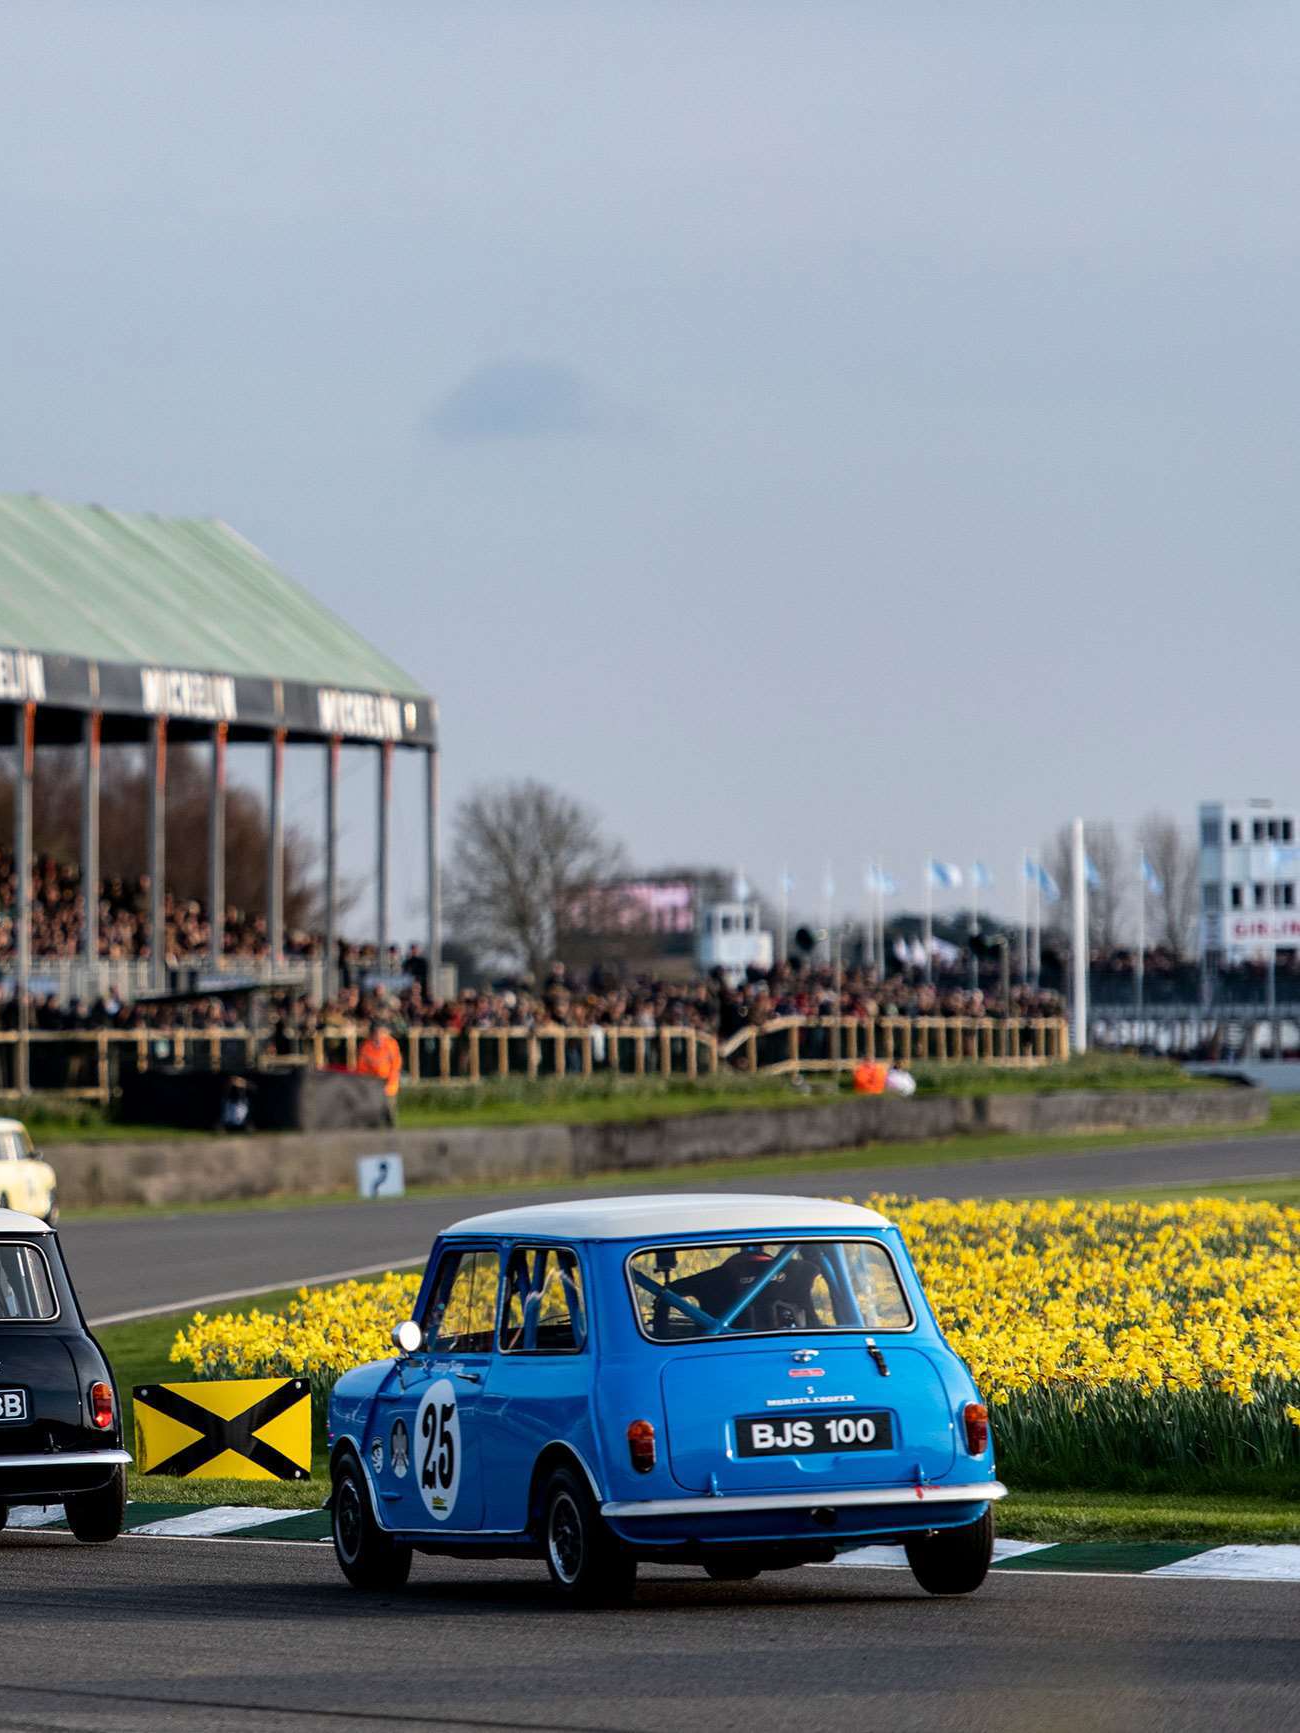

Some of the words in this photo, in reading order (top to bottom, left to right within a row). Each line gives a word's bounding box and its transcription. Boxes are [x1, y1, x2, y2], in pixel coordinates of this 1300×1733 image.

[141, 669, 237, 721] MICHELIN
[806, 1386, 815, 1395] S
[422, 1402, 456, 1490] 25
[751, 1421, 815, 1449] BJS
[825, 1418, 876, 1444] 100
